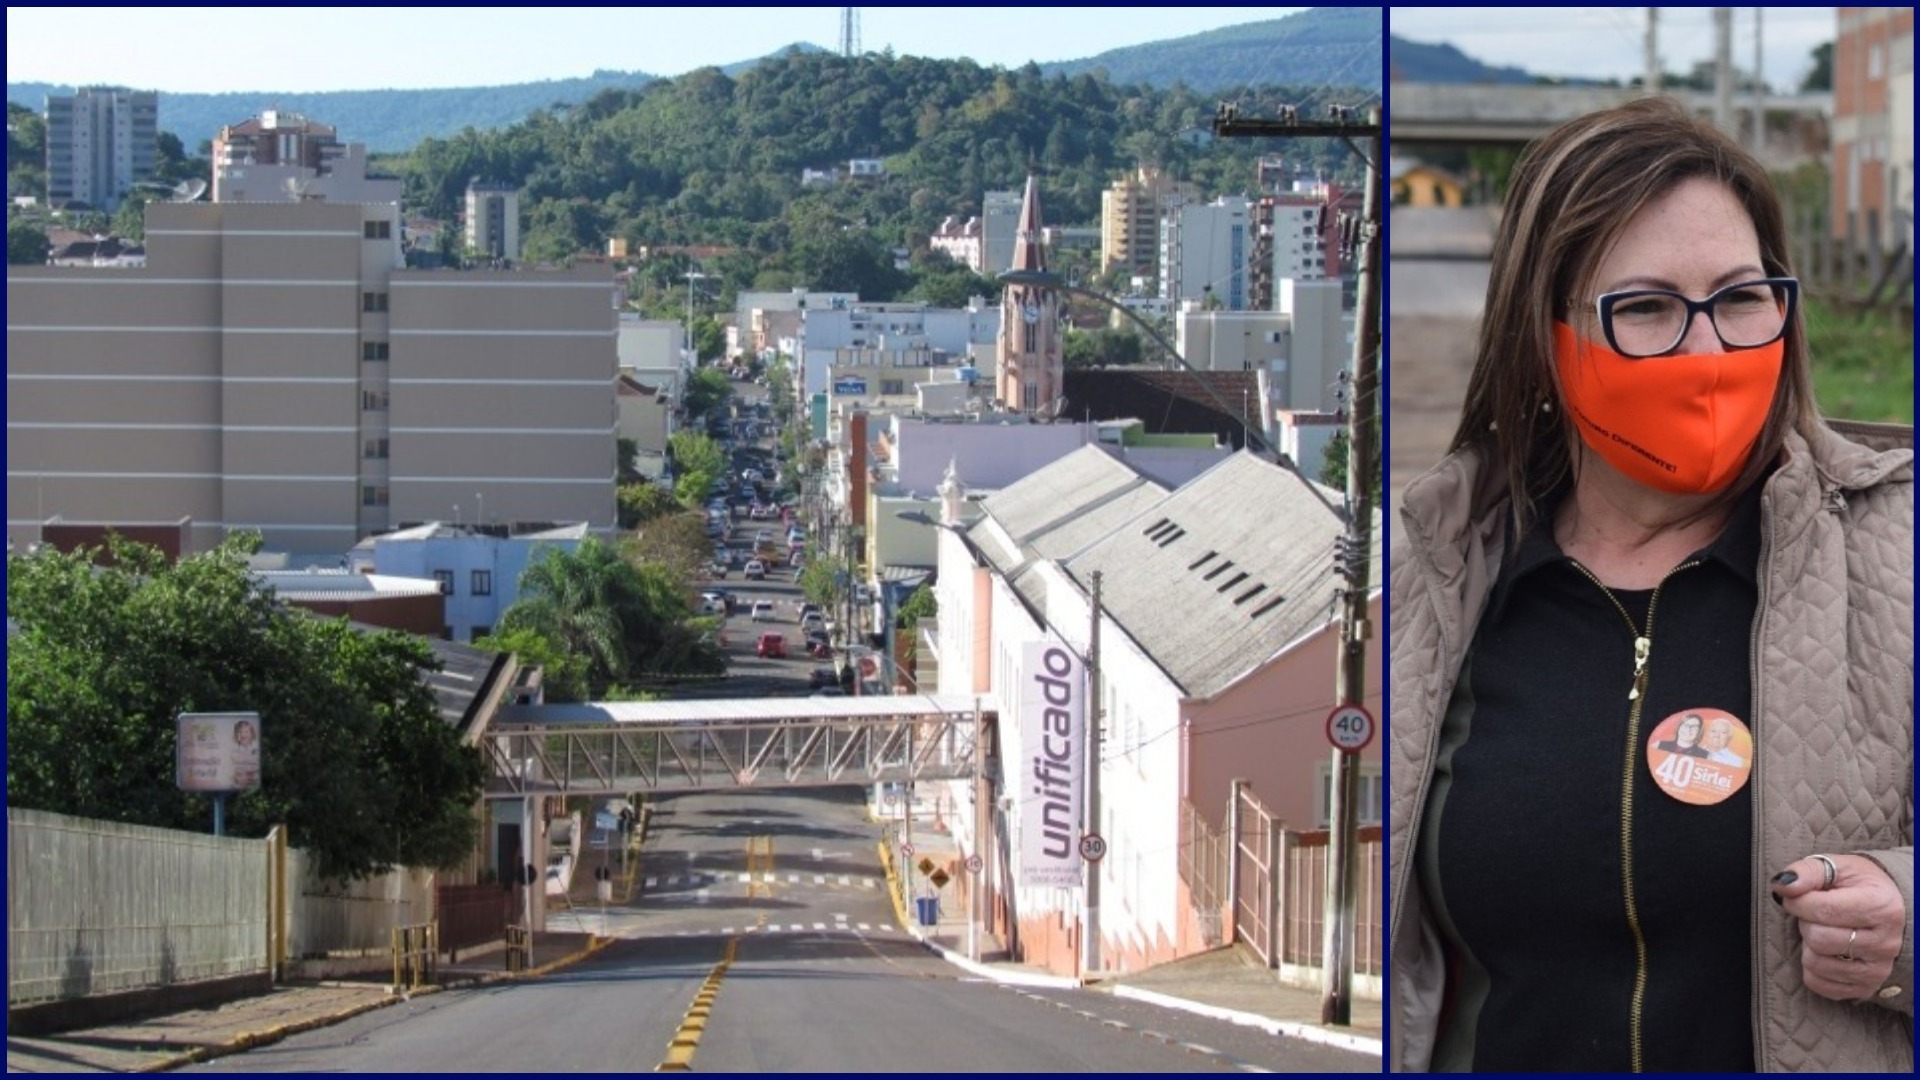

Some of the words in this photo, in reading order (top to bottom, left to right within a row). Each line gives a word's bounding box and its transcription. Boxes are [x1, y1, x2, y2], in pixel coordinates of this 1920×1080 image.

[1336, 716, 1364, 734] 40
[1034, 647, 1072, 860] unificado
[1655, 753, 1694, 788] 40
[1692, 766, 1733, 788] Sirlei
[1084, 840, 1101, 854] 30
